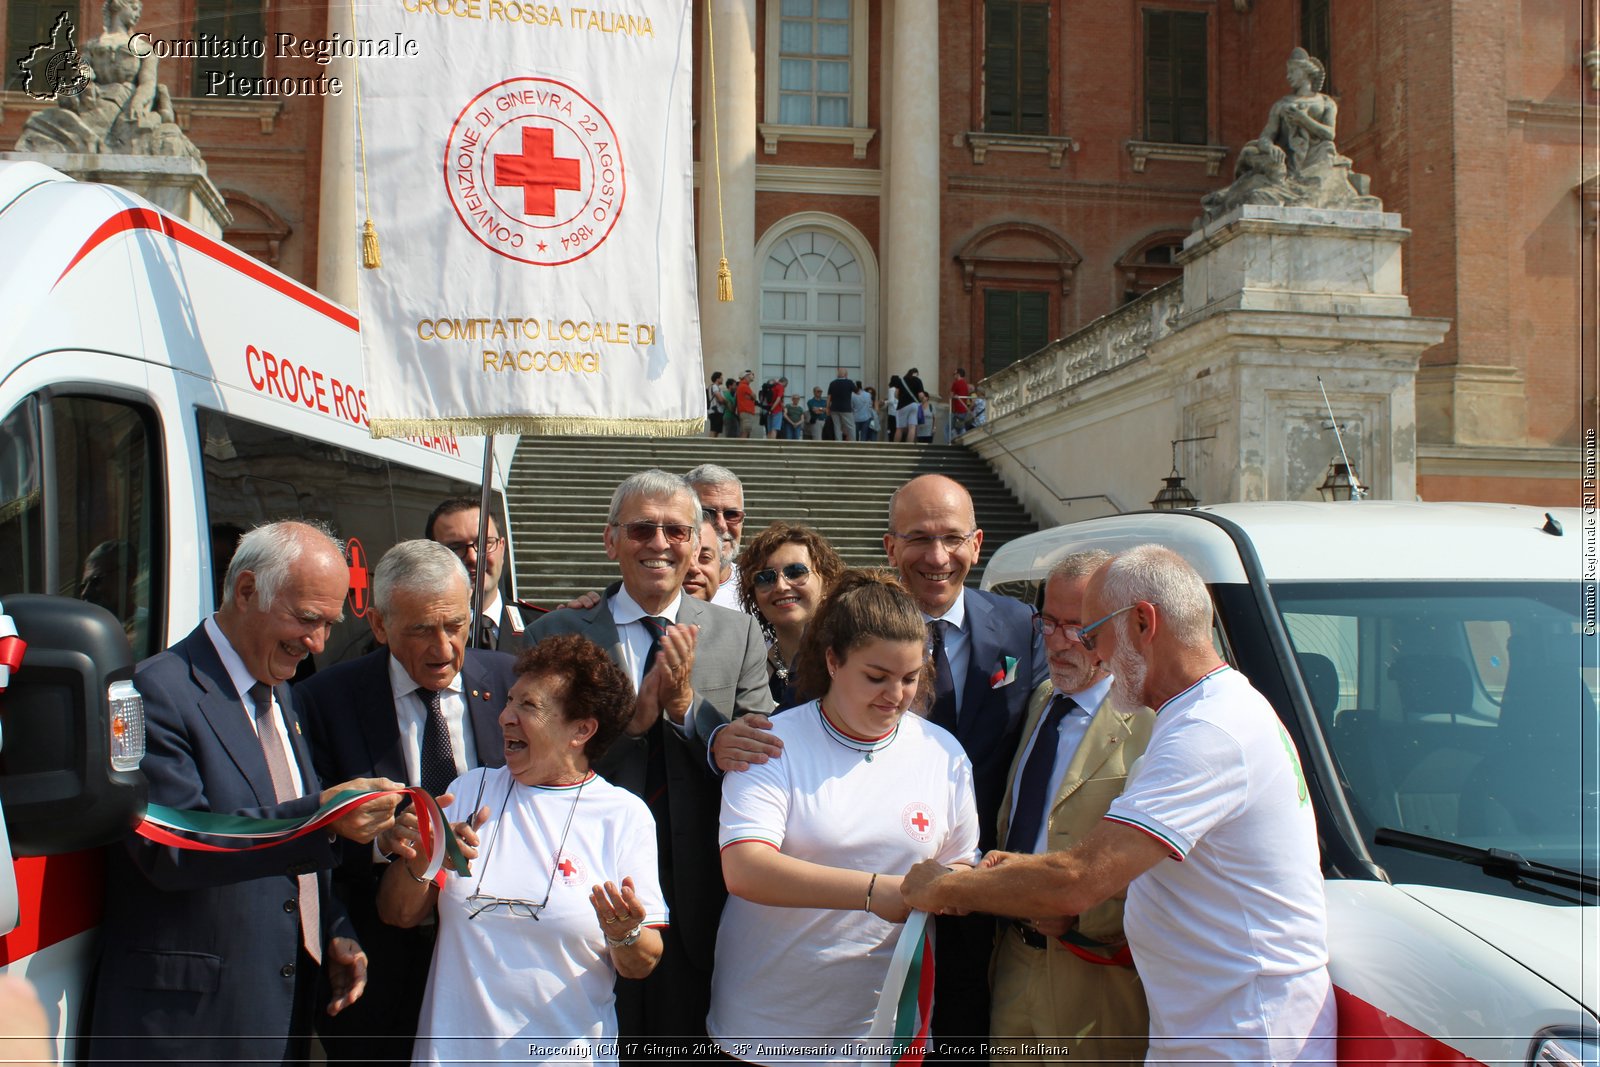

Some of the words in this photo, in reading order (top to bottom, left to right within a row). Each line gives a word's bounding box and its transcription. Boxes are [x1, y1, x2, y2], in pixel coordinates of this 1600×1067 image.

[402, 0, 481, 19] CROCE
[488, 1, 564, 28] ROSSA
[570, 7, 656, 38] ITALIANA
[495, 90, 574, 117] GINEVRA
[475, 107, 494, 128] DI
[578, 114, 599, 136] 22
[457, 127, 524, 249] CONVENZIONE
[593, 140, 616, 222] AGOSTO
[560, 226, 594, 251] 1864
[417, 318, 541, 341] COMITATO
[548, 319, 630, 345] LOCALE
[637, 324, 655, 345] DI
[483, 350, 600, 373] RACCONIGI
[245, 344, 329, 413] CROCE
